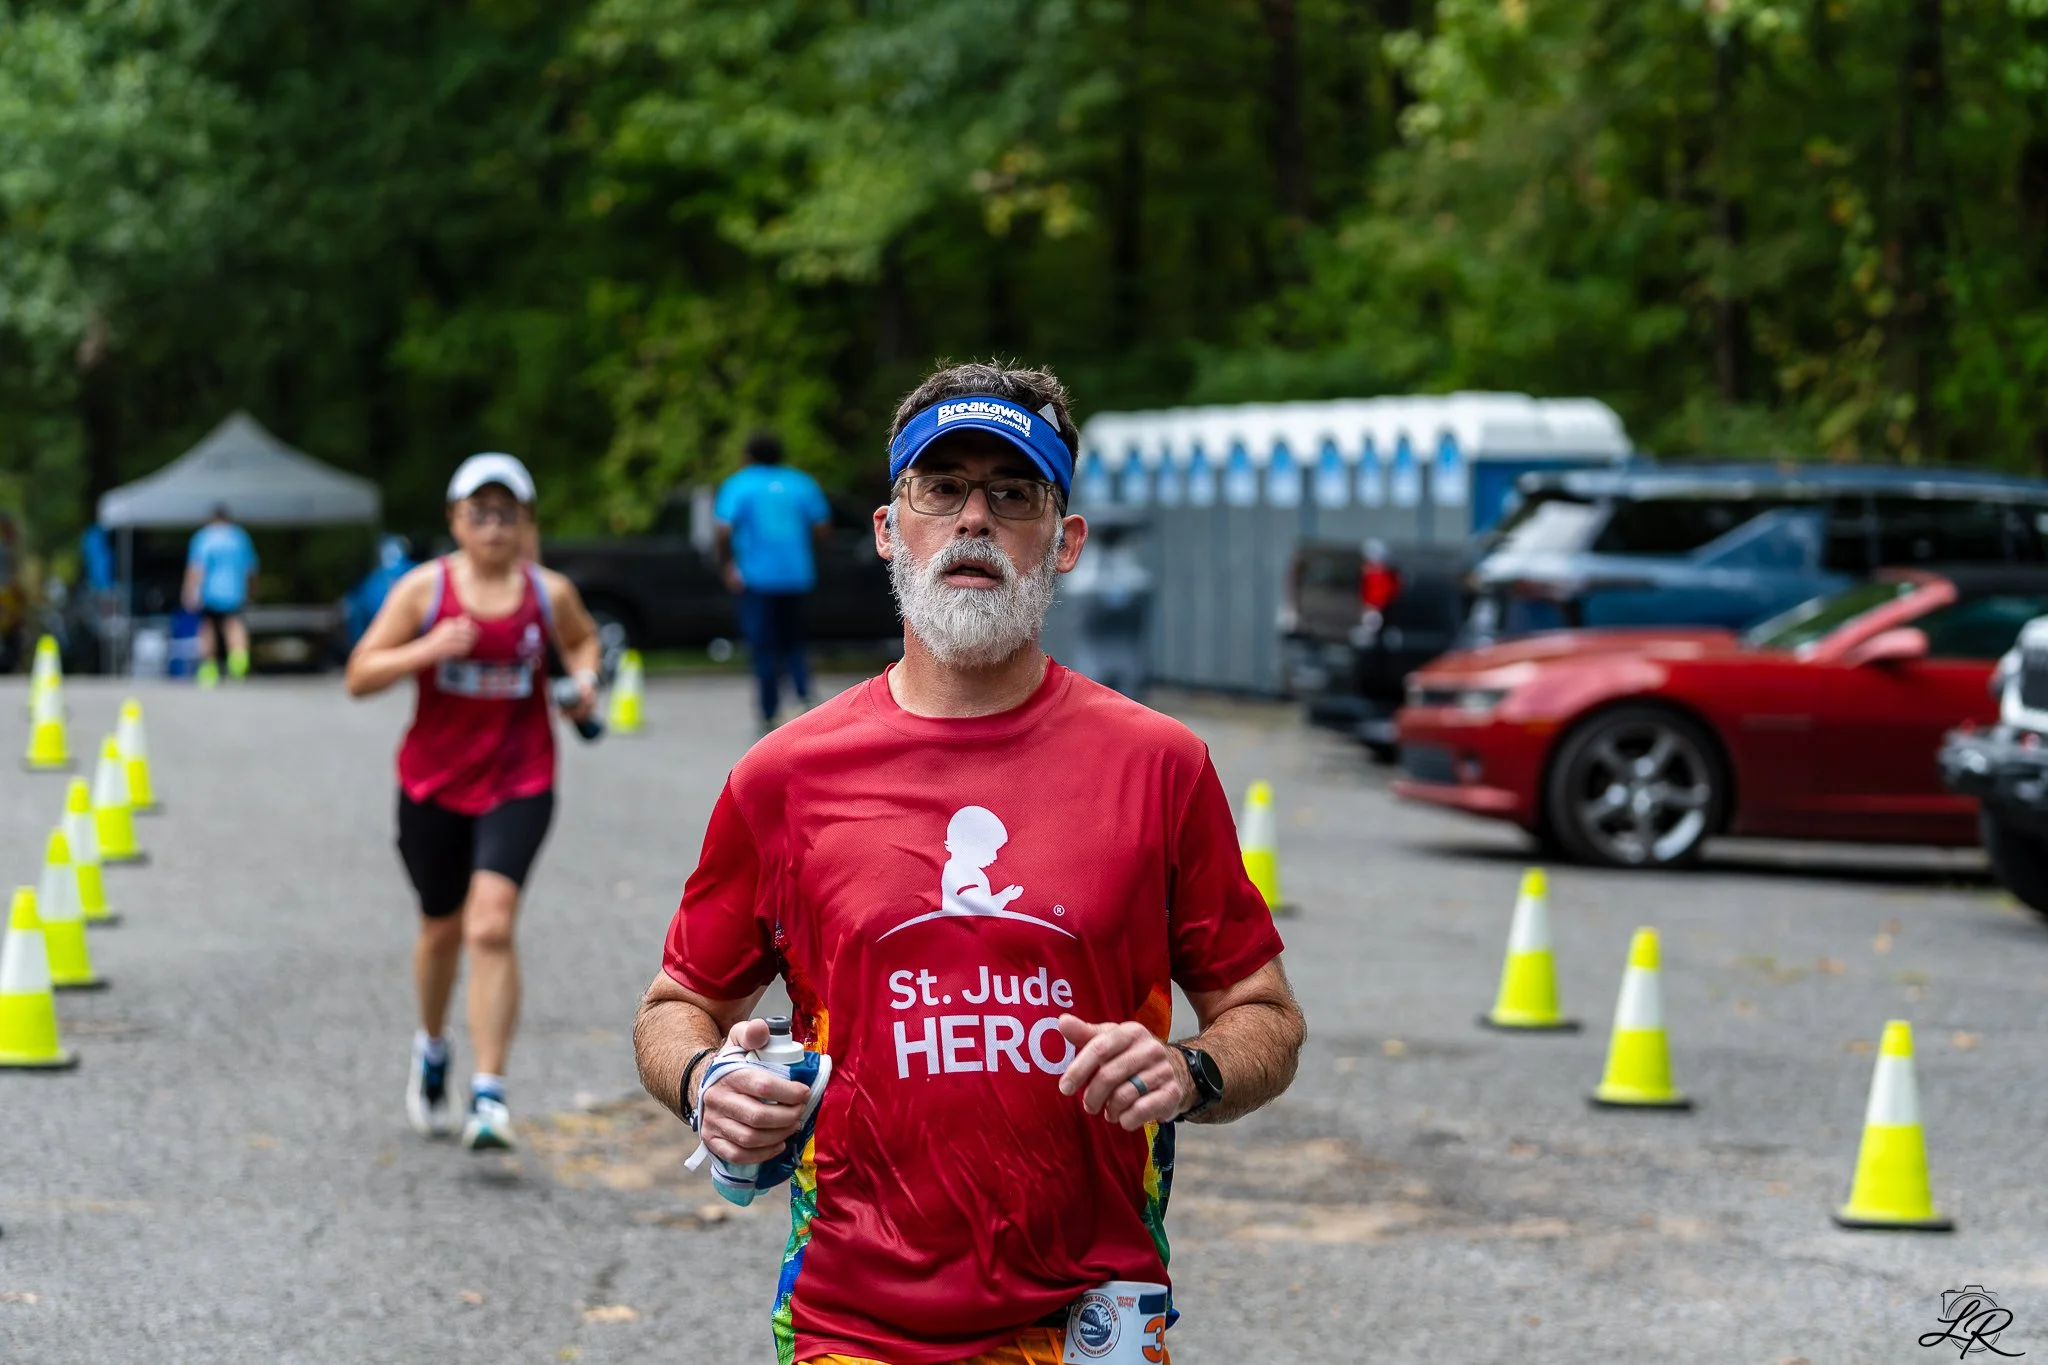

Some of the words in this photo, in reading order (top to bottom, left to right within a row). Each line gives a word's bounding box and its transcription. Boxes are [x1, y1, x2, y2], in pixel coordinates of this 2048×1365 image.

[937, 401, 1031, 430] Breakaway
[992, 415, 1031, 438] Running
[889, 969, 951, 1009] St.
[962, 966, 1073, 1008] Jude
[893, 1014, 1076, 1079] HERO
[1142, 1315, 1165, 1363] 3
